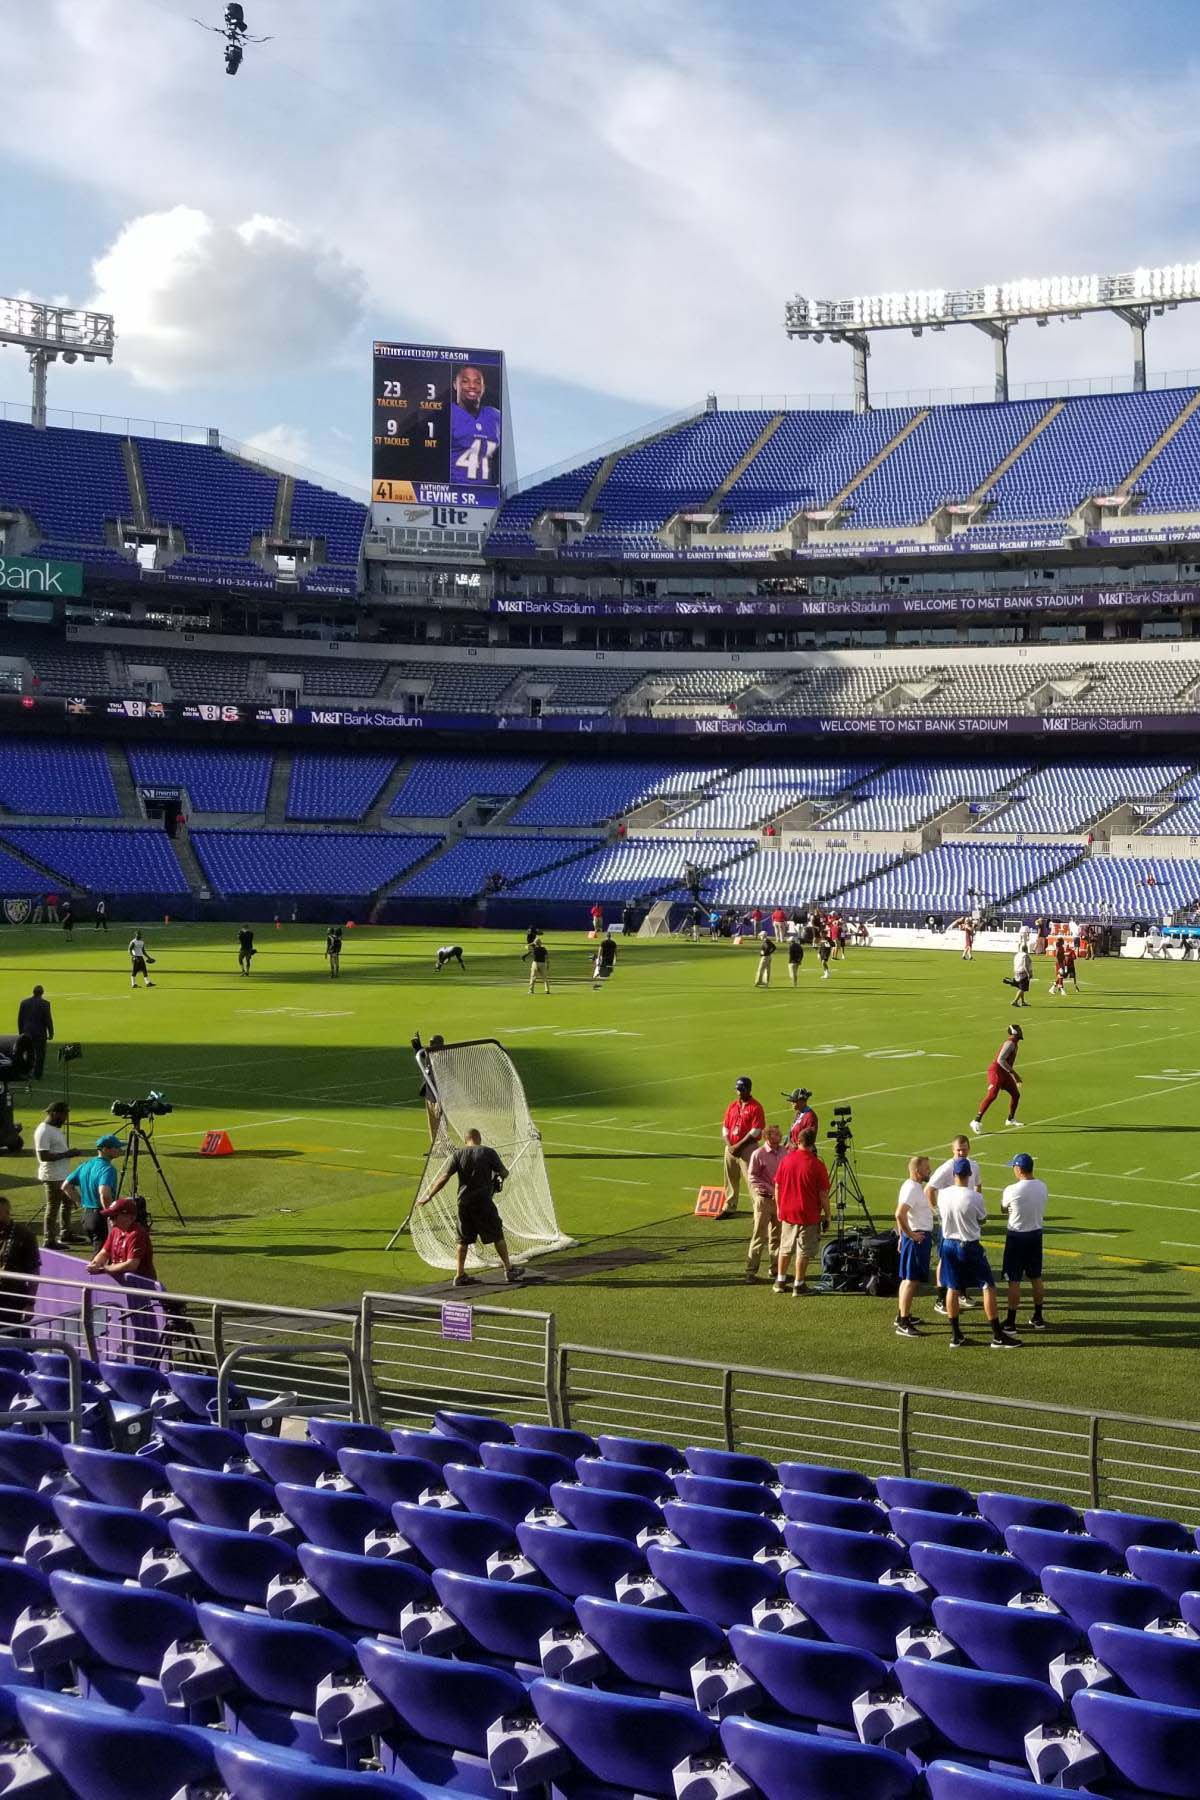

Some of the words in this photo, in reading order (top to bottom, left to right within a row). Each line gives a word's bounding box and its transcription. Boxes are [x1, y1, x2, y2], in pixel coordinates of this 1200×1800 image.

[440, 351, 469, 361] SEASON
[383, 380, 401, 397] 23
[426, 383, 436, 400] 3
[377, 398, 408, 408] TACKLES
[419, 401, 443, 410] SACKS
[387, 419, 397, 435] 9
[427, 422, 434, 438] 1
[424, 440, 438, 448] INT
[455, 438, 497, 480] 41
[376, 481, 393, 500] 41
[420, 483, 450, 492] ANTHONY
[420, 491, 458, 504] LEVINE
[461, 493, 479, 505] SR.
[431, 506, 468, 528] Lite
[1109, 535, 1130, 544] PETER
[1131, 534, 1167, 543] BOULWARE
[970, 542, 999, 551] MICHAEL
[650, 551, 674, 560] HONOR
[687, 551, 716, 560] EARNEST
[215, 577, 273, 589] 410-324-6141
[305, 585, 351, 594] RAVENS
[903, 599, 958, 612] WELCOME
[960, 599, 975, 610] TO
[977, 597, 1001, 609] M&T
[1003, 596, 1034, 608] BANK
[1035, 595, 1083, 607] STADIUM
[1098, 592, 1125, 605] M&T
[1125, 592, 1150, 604] Bank
[1150, 589, 1194, 603] Stadium
[497, 600, 523, 613] M&T
[525, 601, 551, 613] Bank
[551, 602, 596, 614] Stadium
[802, 602, 827, 614] M&T
[827, 602, 850, 613] Bank
[850, 601, 890, 613] Stadium
[311, 711, 343, 724] M&T
[343, 712, 373, 725] Bank
[374, 713, 423, 727] Stadium
[695, 719, 722, 732] M&T
[722, 720, 745, 732] Bank
[745, 720, 787, 732] Stadium
[820, 720, 877, 732] WELCOME
[879, 719, 895, 731] TO
[897, 719, 923, 731] M&T
[925, 719, 956, 731] BANK
[958, 719, 1008, 731] STADIUM
[1042, 717, 1070, 731] M&T
[1071, 718, 1098, 730] Bank
[1098, 718, 1143, 730] Stadium
[201, 1133, 222, 1153] 30
[696, 1189, 723, 1213] 20
